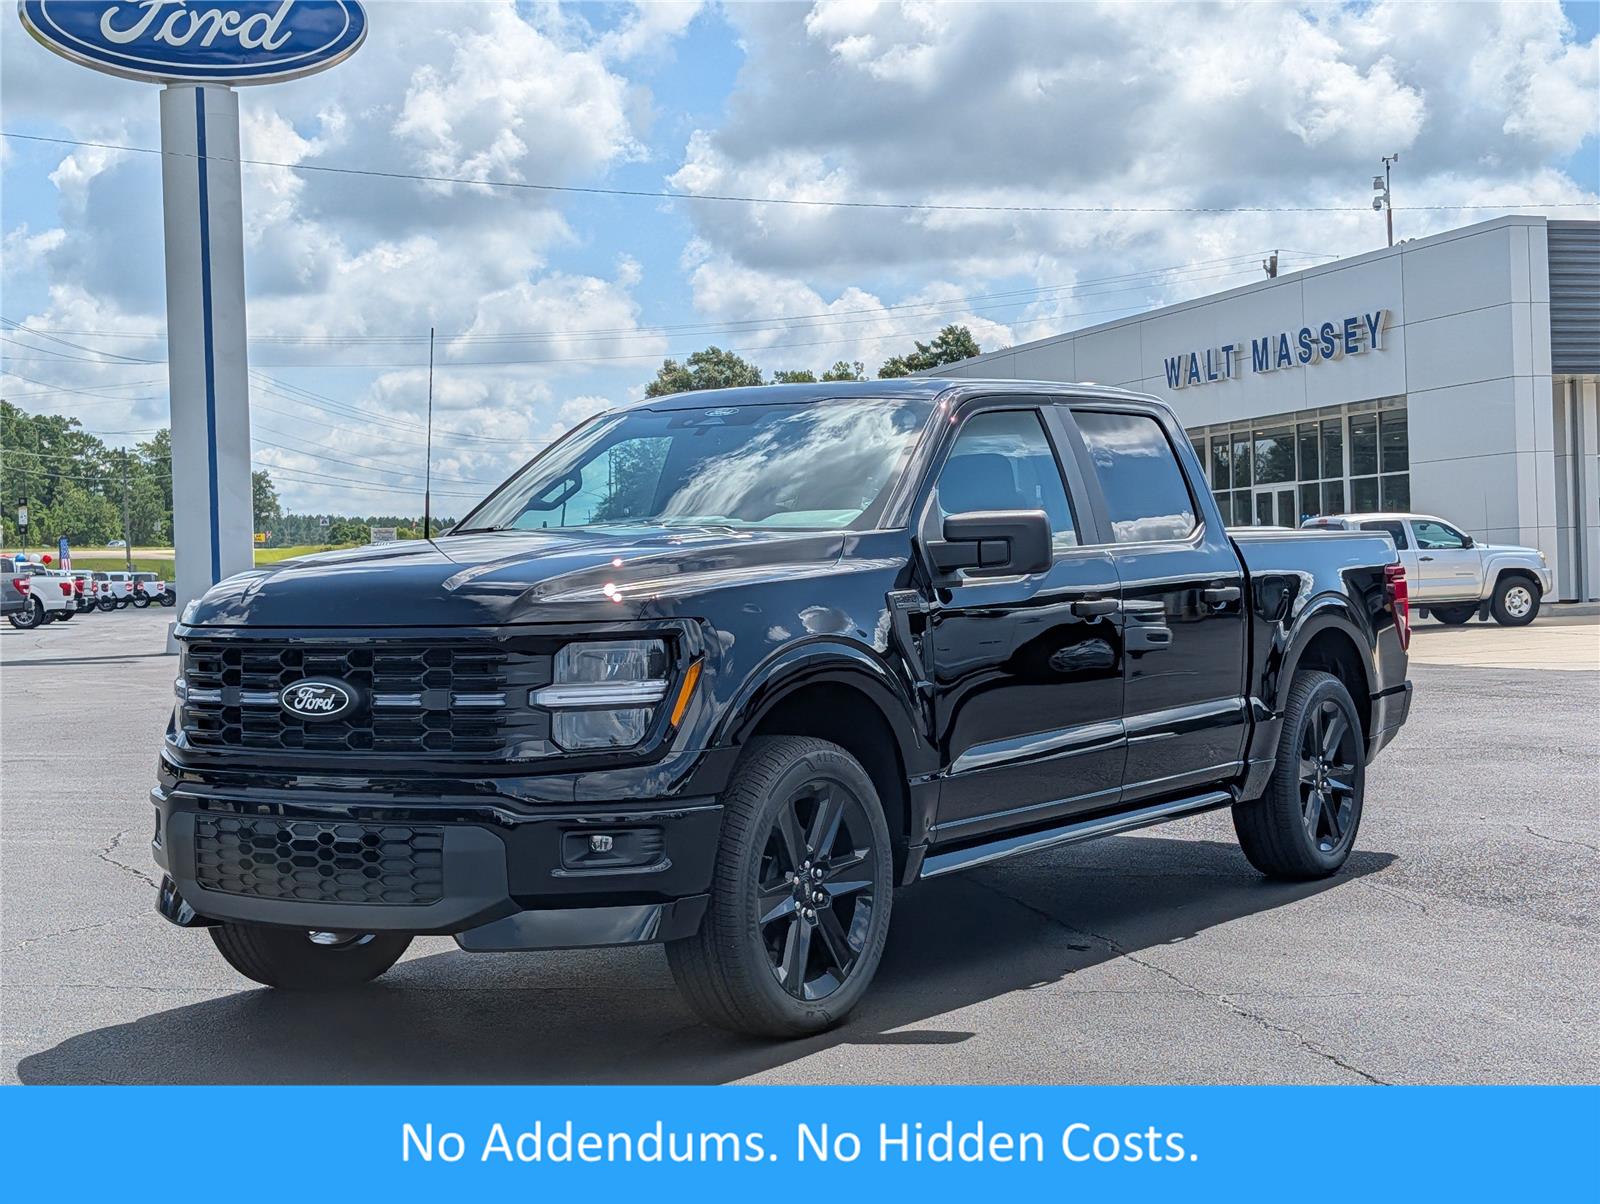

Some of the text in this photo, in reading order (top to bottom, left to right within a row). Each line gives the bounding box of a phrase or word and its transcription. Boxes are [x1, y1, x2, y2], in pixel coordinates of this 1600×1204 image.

[101, 0, 292, 50] Ford
[1164, 309, 1388, 390] WALT MASSEY
[294, 687, 336, 710] Ford
